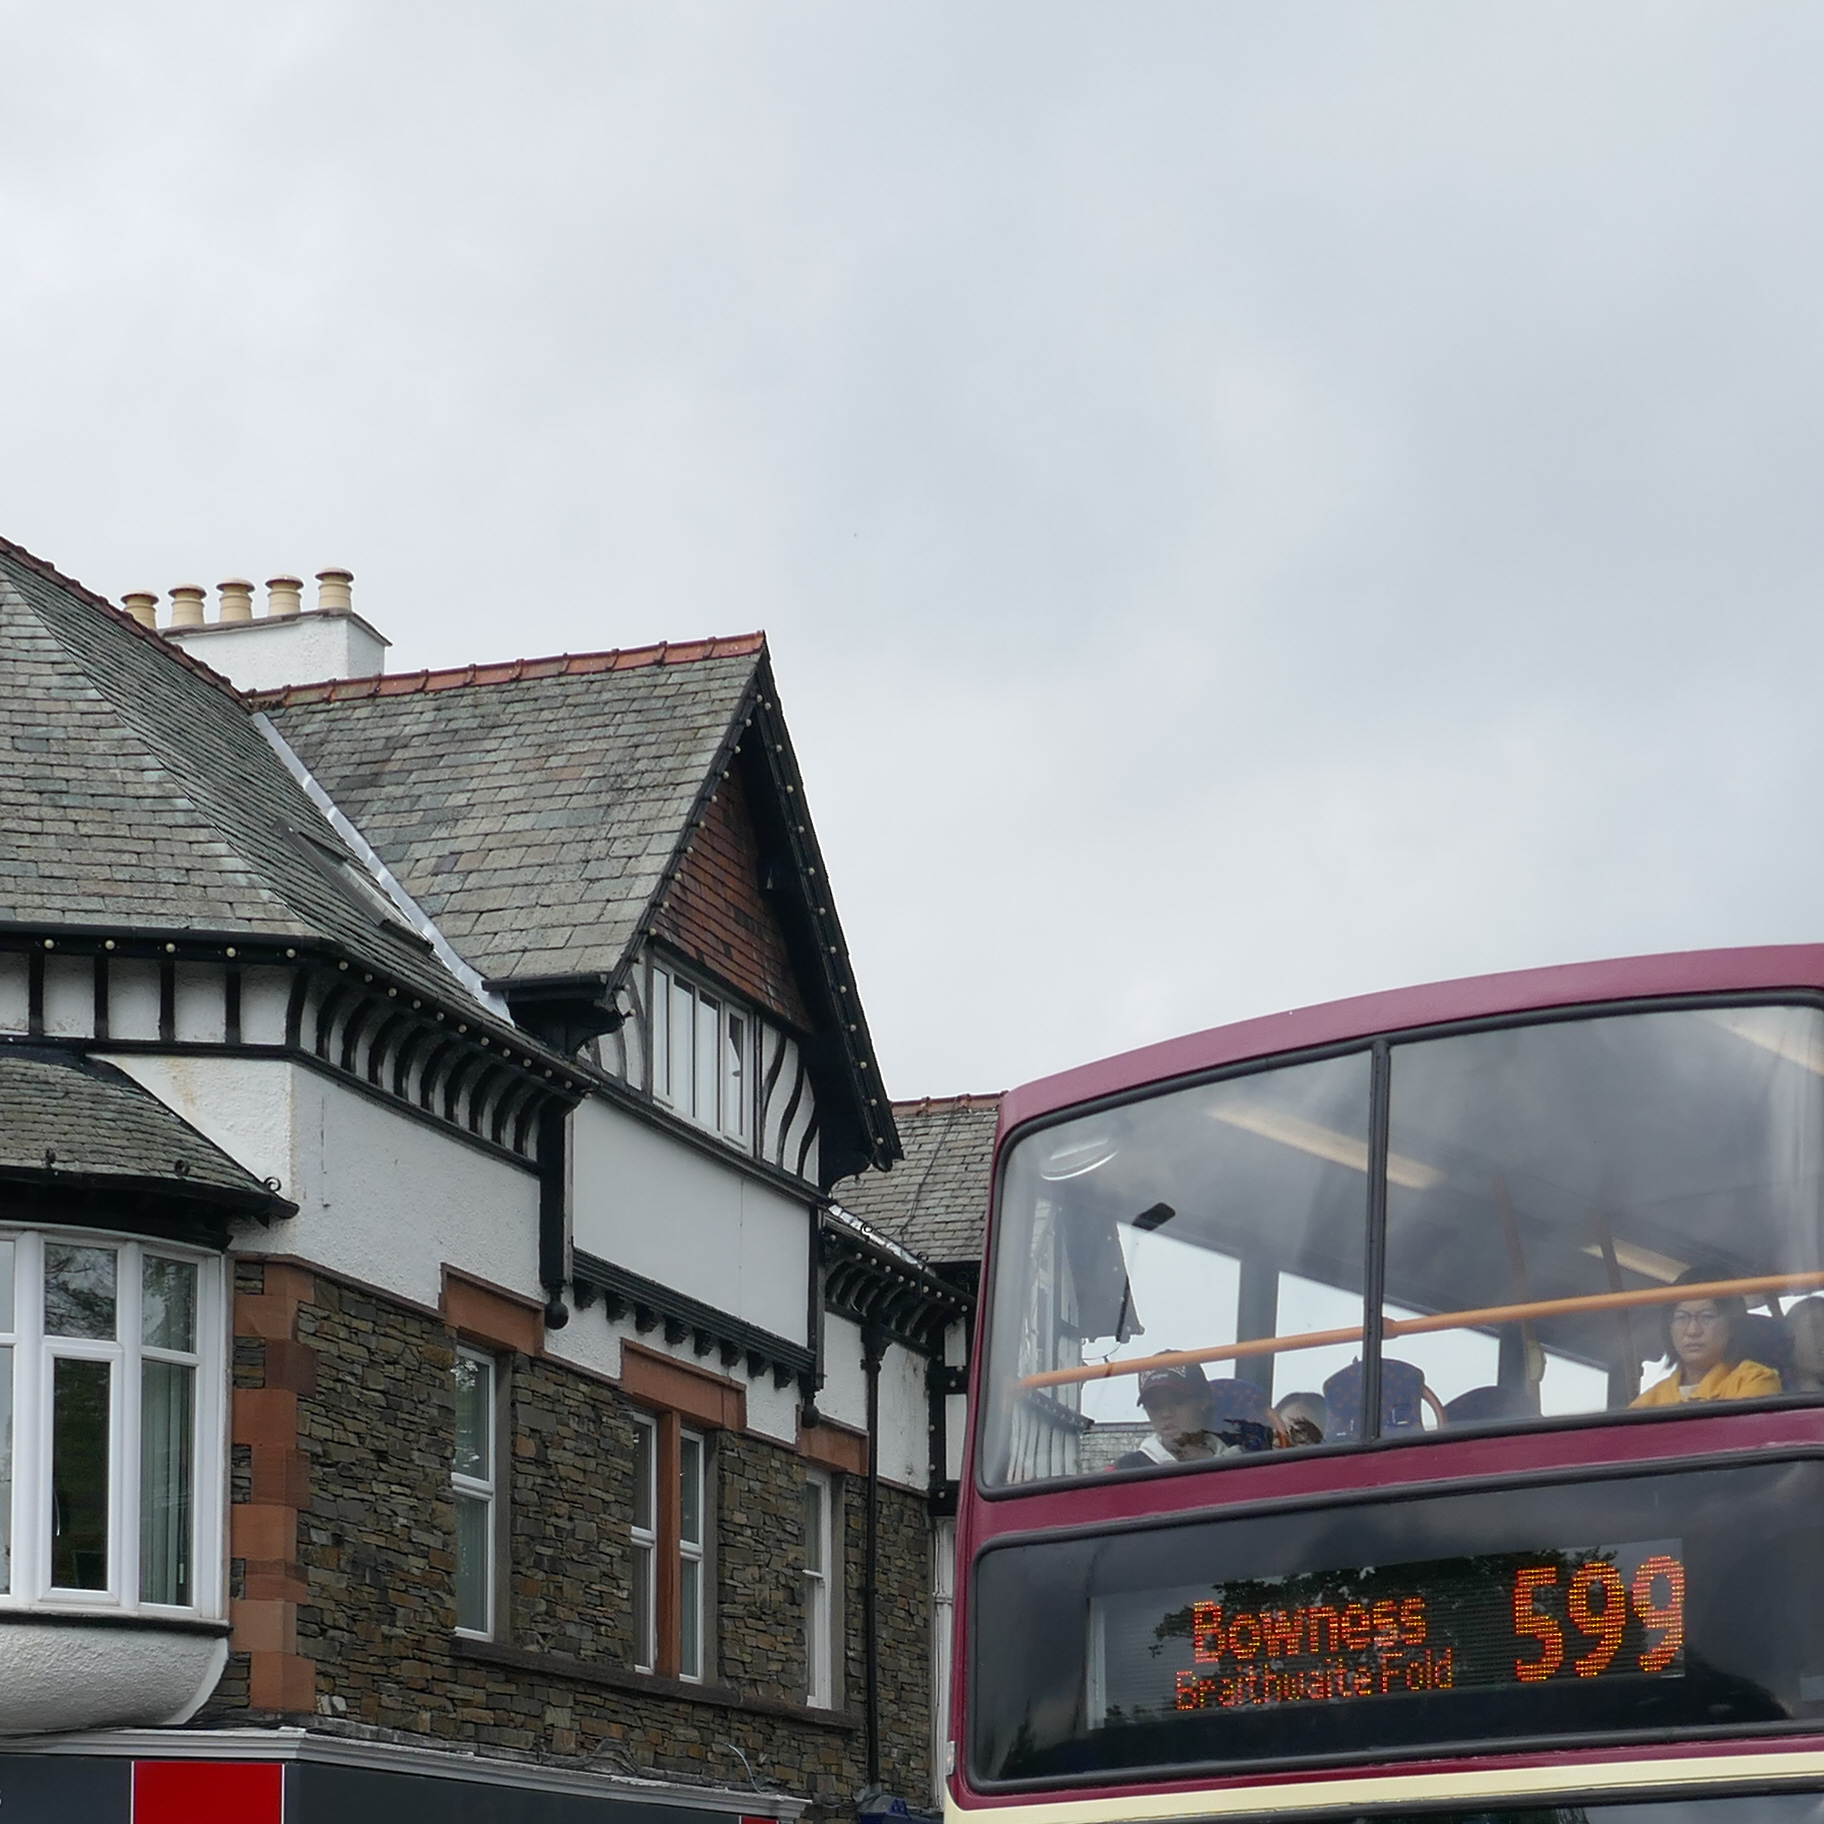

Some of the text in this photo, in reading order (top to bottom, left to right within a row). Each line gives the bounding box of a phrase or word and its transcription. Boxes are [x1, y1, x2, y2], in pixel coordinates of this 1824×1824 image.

[1192, 1555, 1686, 1683] Bowness 599
[1175, 1646, 1454, 1711] Braithwaite Fold
